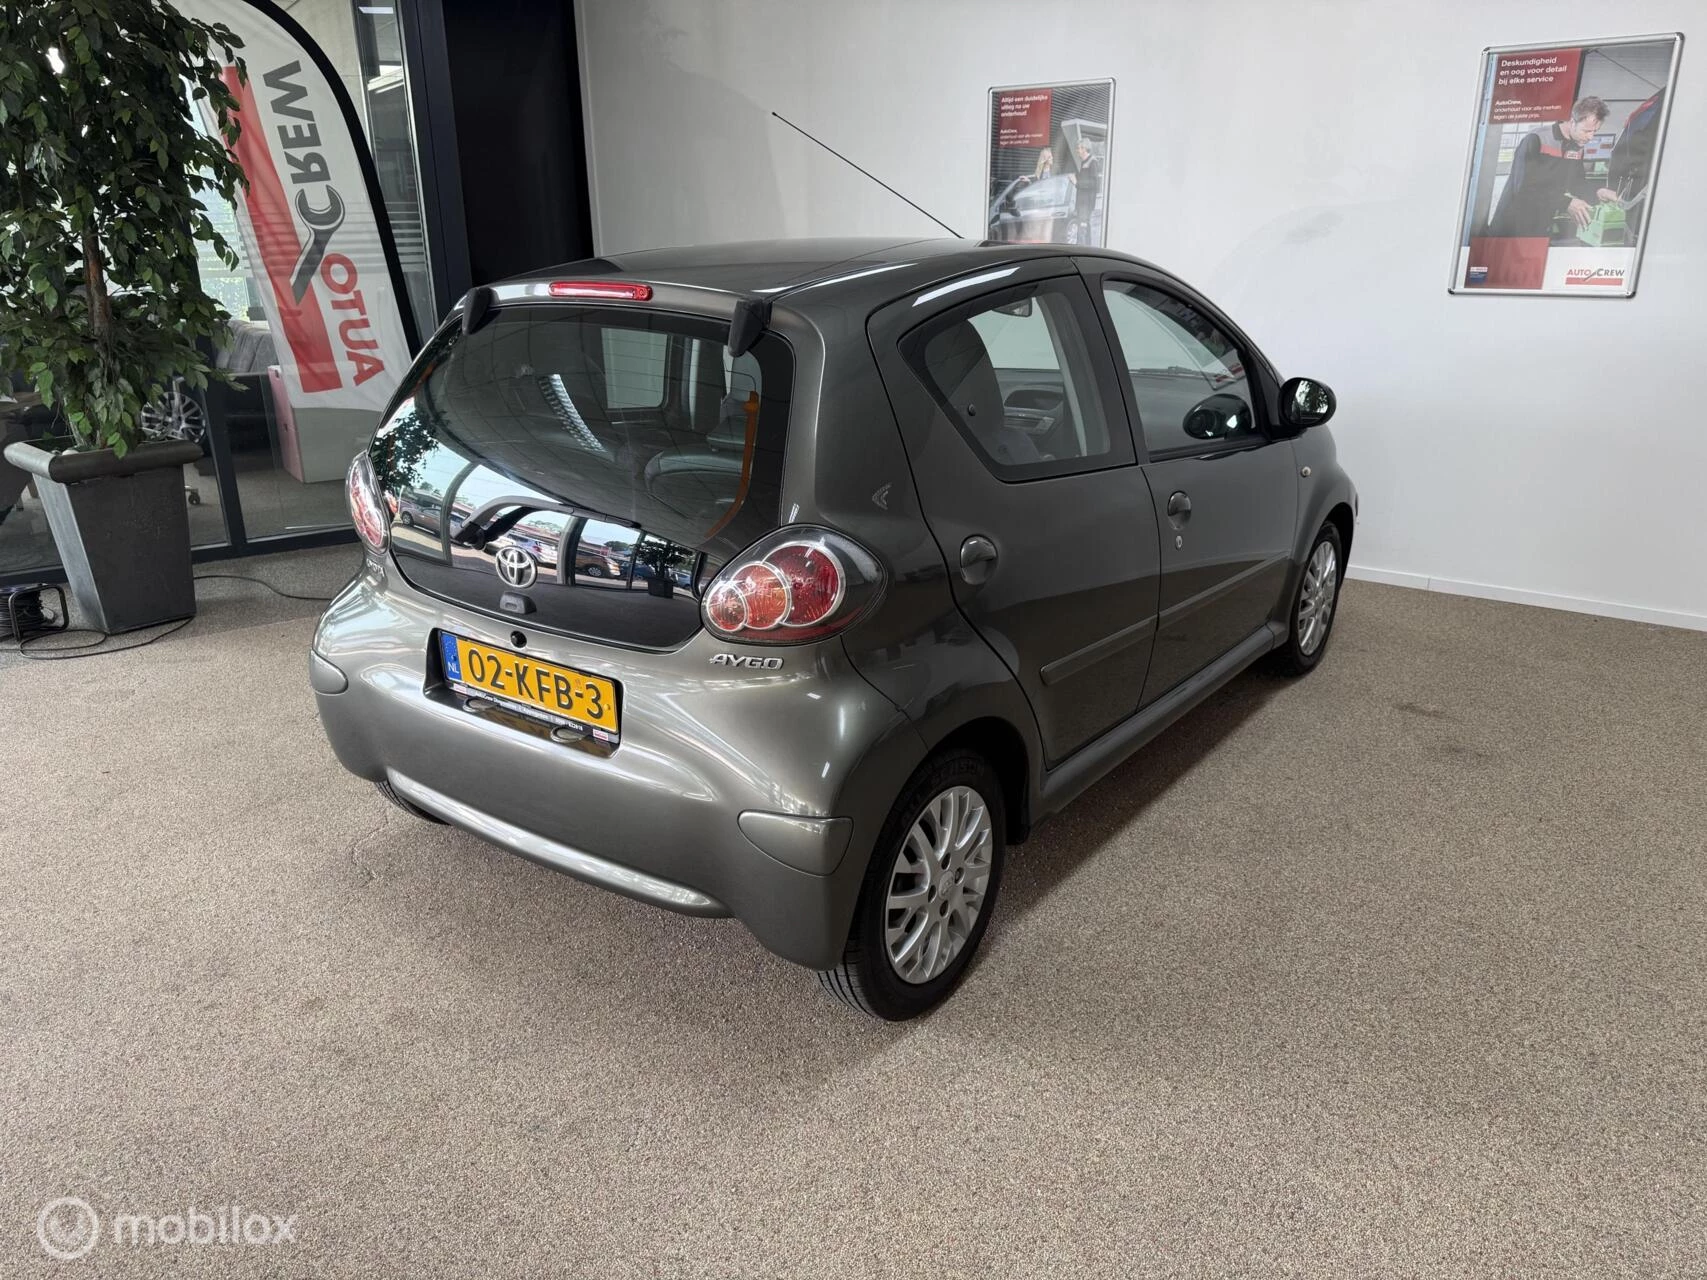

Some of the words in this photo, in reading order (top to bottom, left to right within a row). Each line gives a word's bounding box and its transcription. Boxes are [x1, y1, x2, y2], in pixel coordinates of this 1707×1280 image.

[1501, 56, 1557, 67] Deskundigheid
[1546, 64, 1568, 73] detail
[1498, 78, 1508, 86] bij
[1567, 268, 1592, 276] AUTO
[1596, 268, 1625, 276] CREW
[708, 652, 784, 670] AYGO
[447, 661, 460, 675] NL
[467, 648, 605, 720] 02-KFB-3
